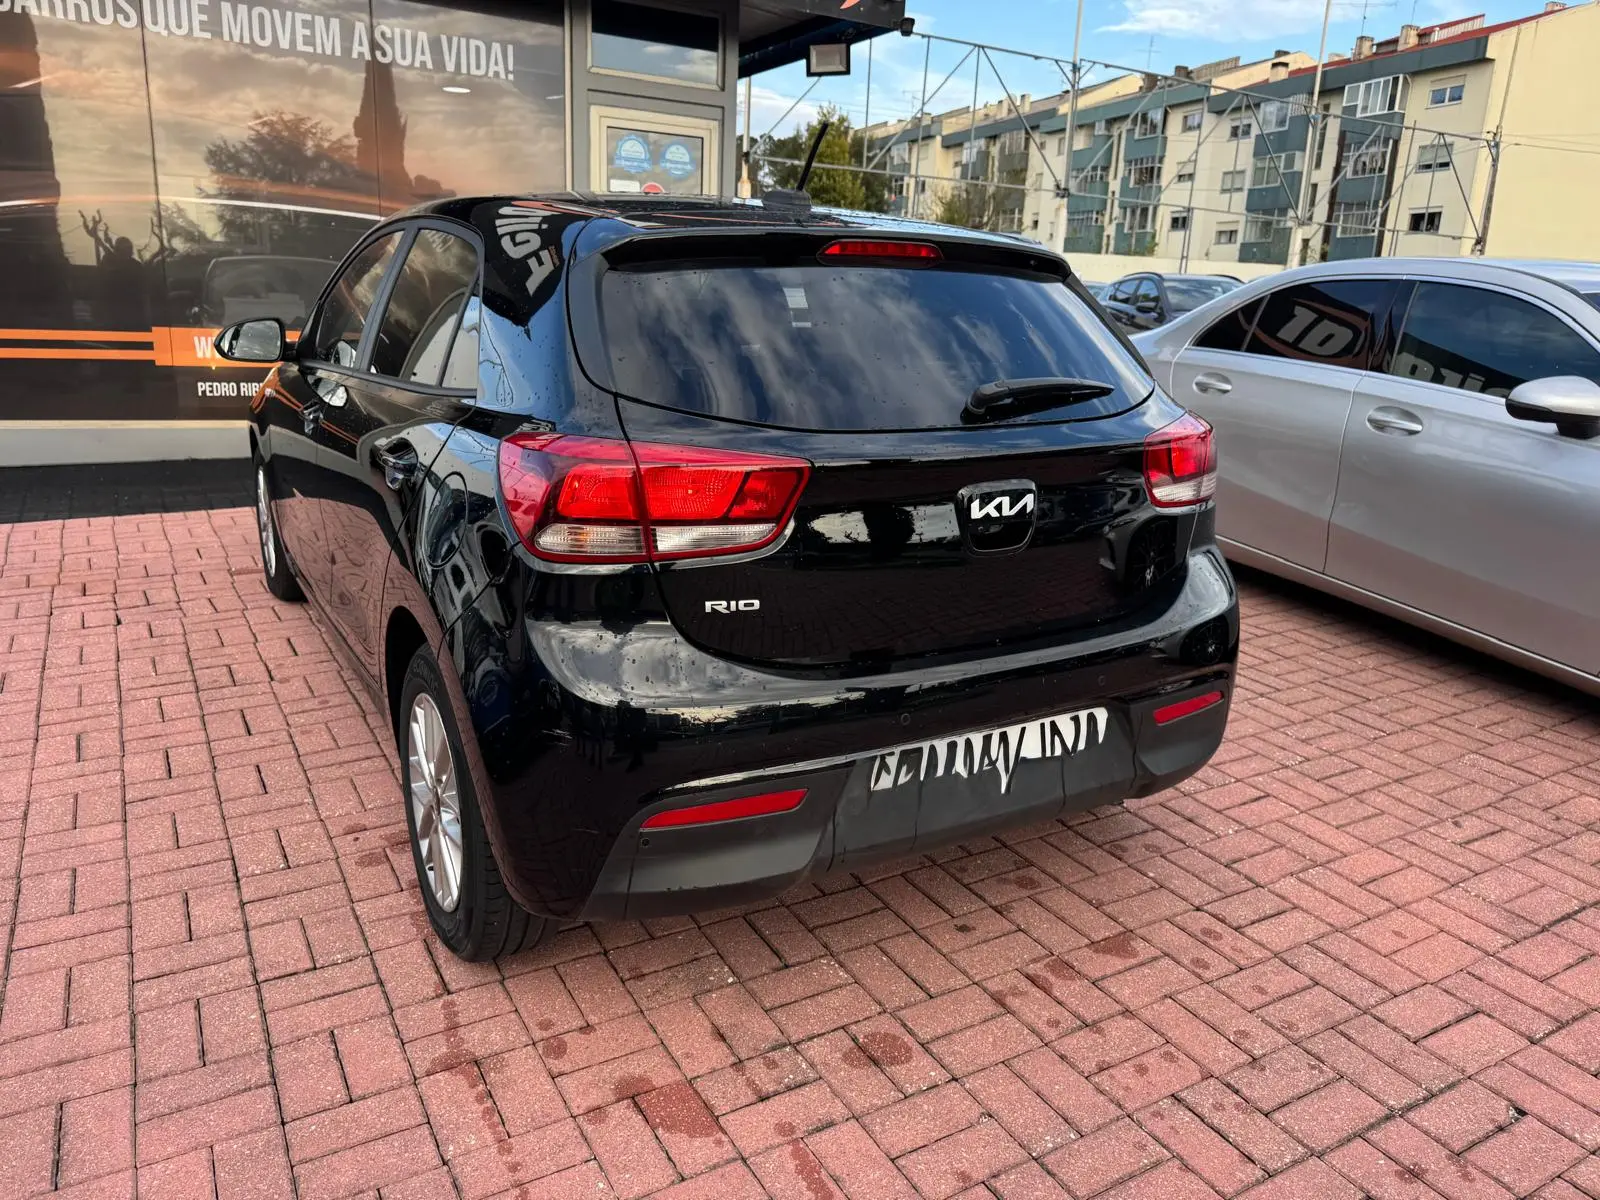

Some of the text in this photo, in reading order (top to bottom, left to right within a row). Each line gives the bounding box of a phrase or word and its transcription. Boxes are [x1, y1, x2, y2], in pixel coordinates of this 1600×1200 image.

[144, 0, 211, 39] QUE
[220, 1, 341, 56] MOVEM
[352, 21, 371, 61] A
[374, 24, 433, 70] SUA
[440, 34, 514, 80] VIDA!
[197, 381, 237, 397] PEDRO
[970, 493, 1034, 519] KIA
[705, 600, 760, 613] RIO
